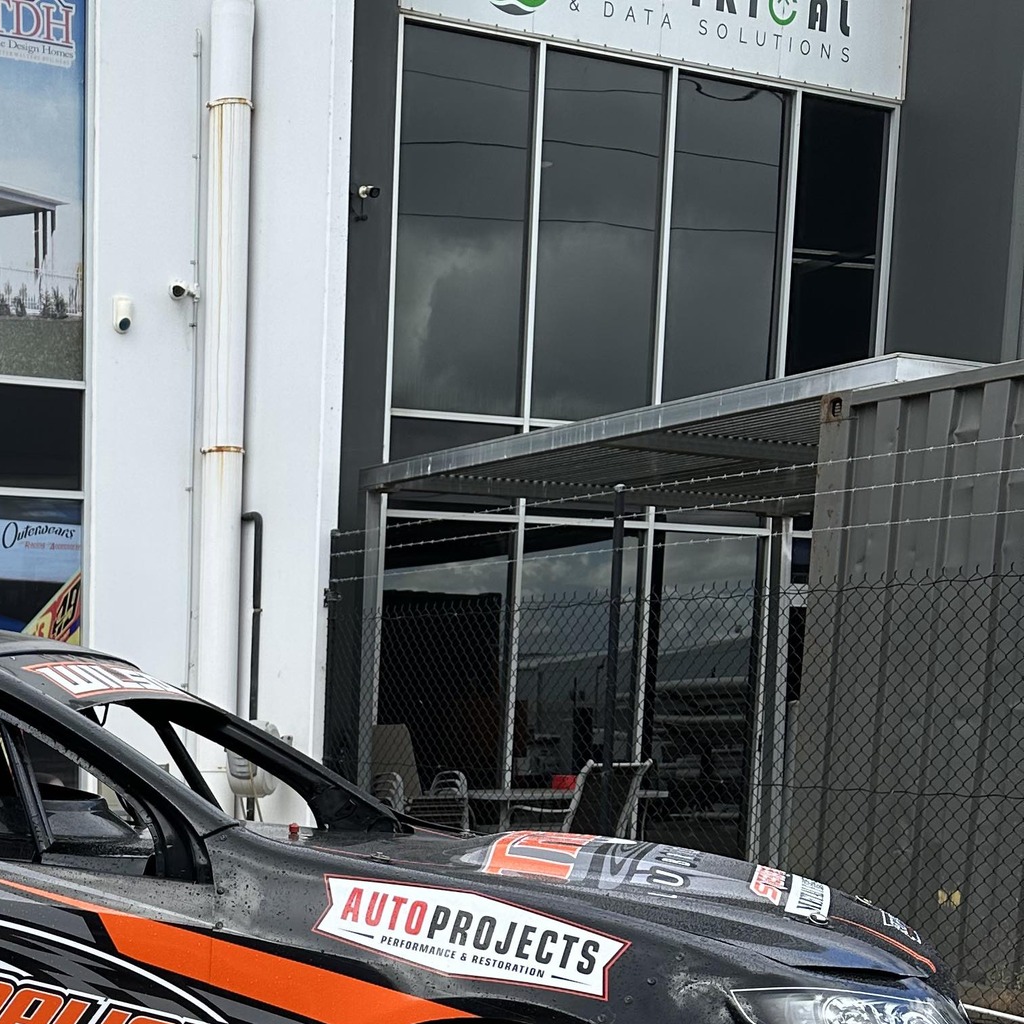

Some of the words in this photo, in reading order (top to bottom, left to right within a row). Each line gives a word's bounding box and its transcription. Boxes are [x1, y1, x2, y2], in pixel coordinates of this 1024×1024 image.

[8, 40, 39, 54] Design
[42, 45, 73, 58] Homes
[603, 2, 672, 30] DATA
[698, 19, 850, 63] SOLUTIONS
[2, 521, 76, 549] Outerwears
[340, 886, 600, 976] AUTOPROJECTS
[380, 935, 457, 961] PERFORMANCE
[460, 952, 468, 962] &
[471, 955, 545, 979] RESTORATION
